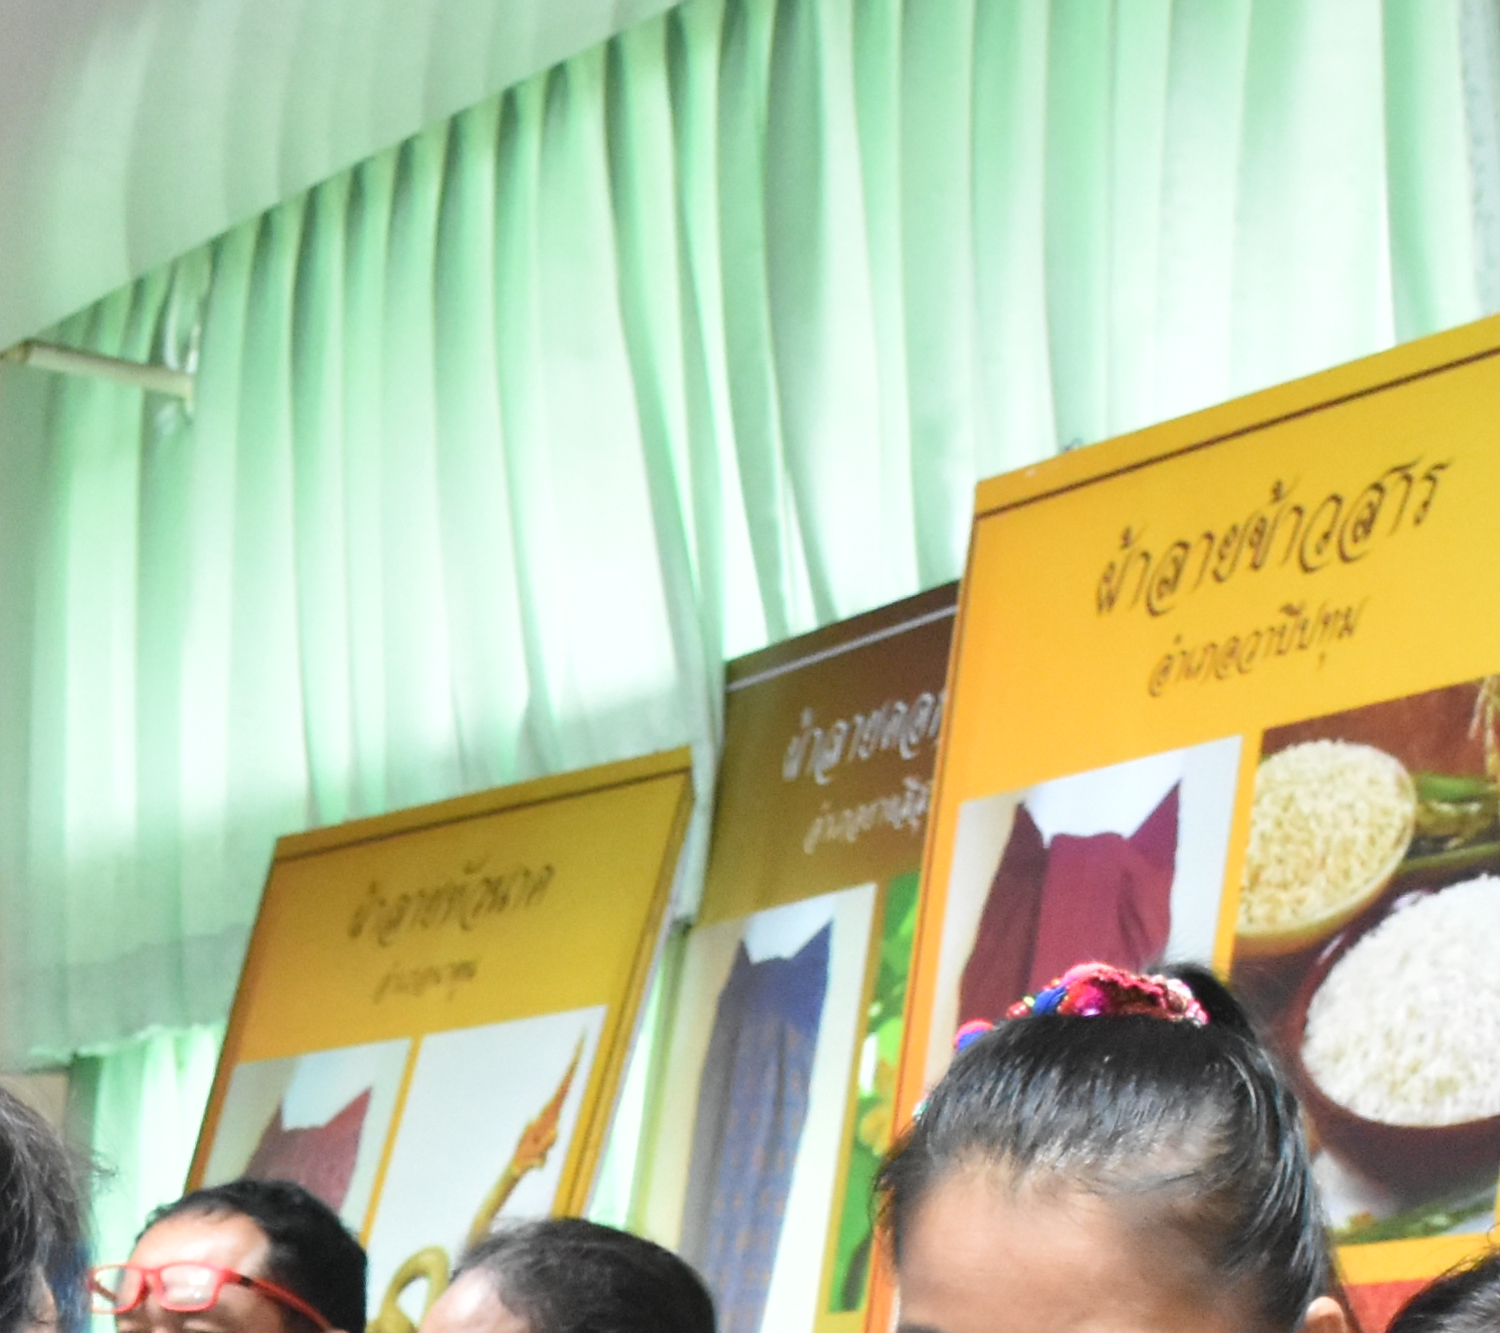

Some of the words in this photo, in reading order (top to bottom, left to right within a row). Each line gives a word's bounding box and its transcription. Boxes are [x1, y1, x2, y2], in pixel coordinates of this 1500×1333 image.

[1097, 457, 1452, 617] ผ้าลายข้าวสาร
